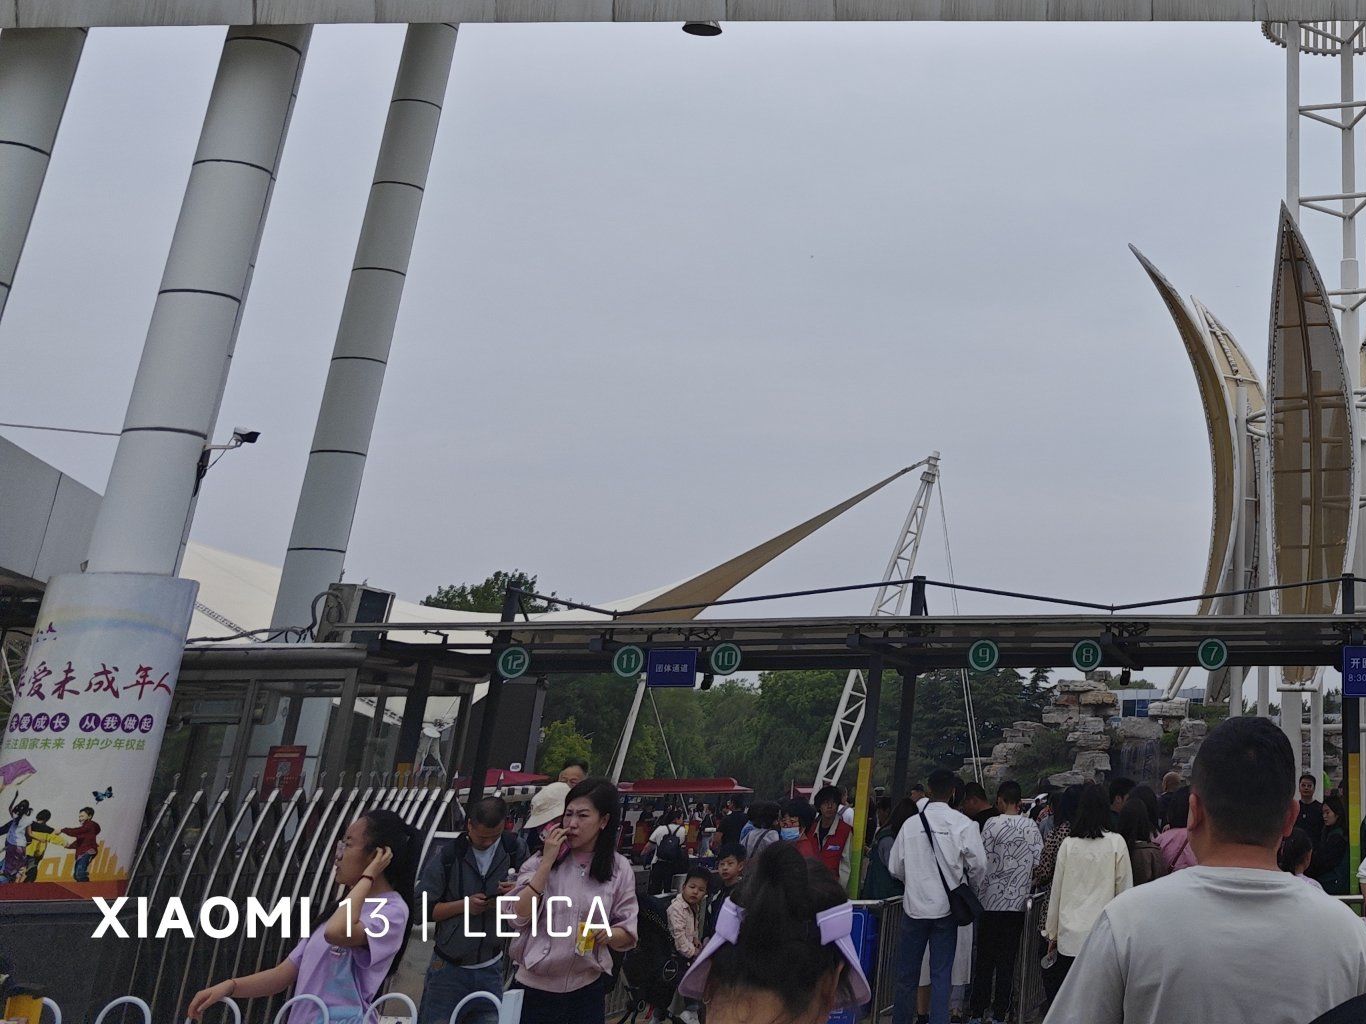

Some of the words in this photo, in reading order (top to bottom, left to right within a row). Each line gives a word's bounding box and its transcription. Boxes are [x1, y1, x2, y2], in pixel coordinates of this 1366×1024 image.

[506, 654, 524, 670] 12
[620, 653, 636, 668] 11
[717, 650, 736, 666] 10
[655, 663, 689, 674] 团体通道
[79, 712, 154, 733] 从我做起
[71, 737, 146, 751] 保护少年权益
